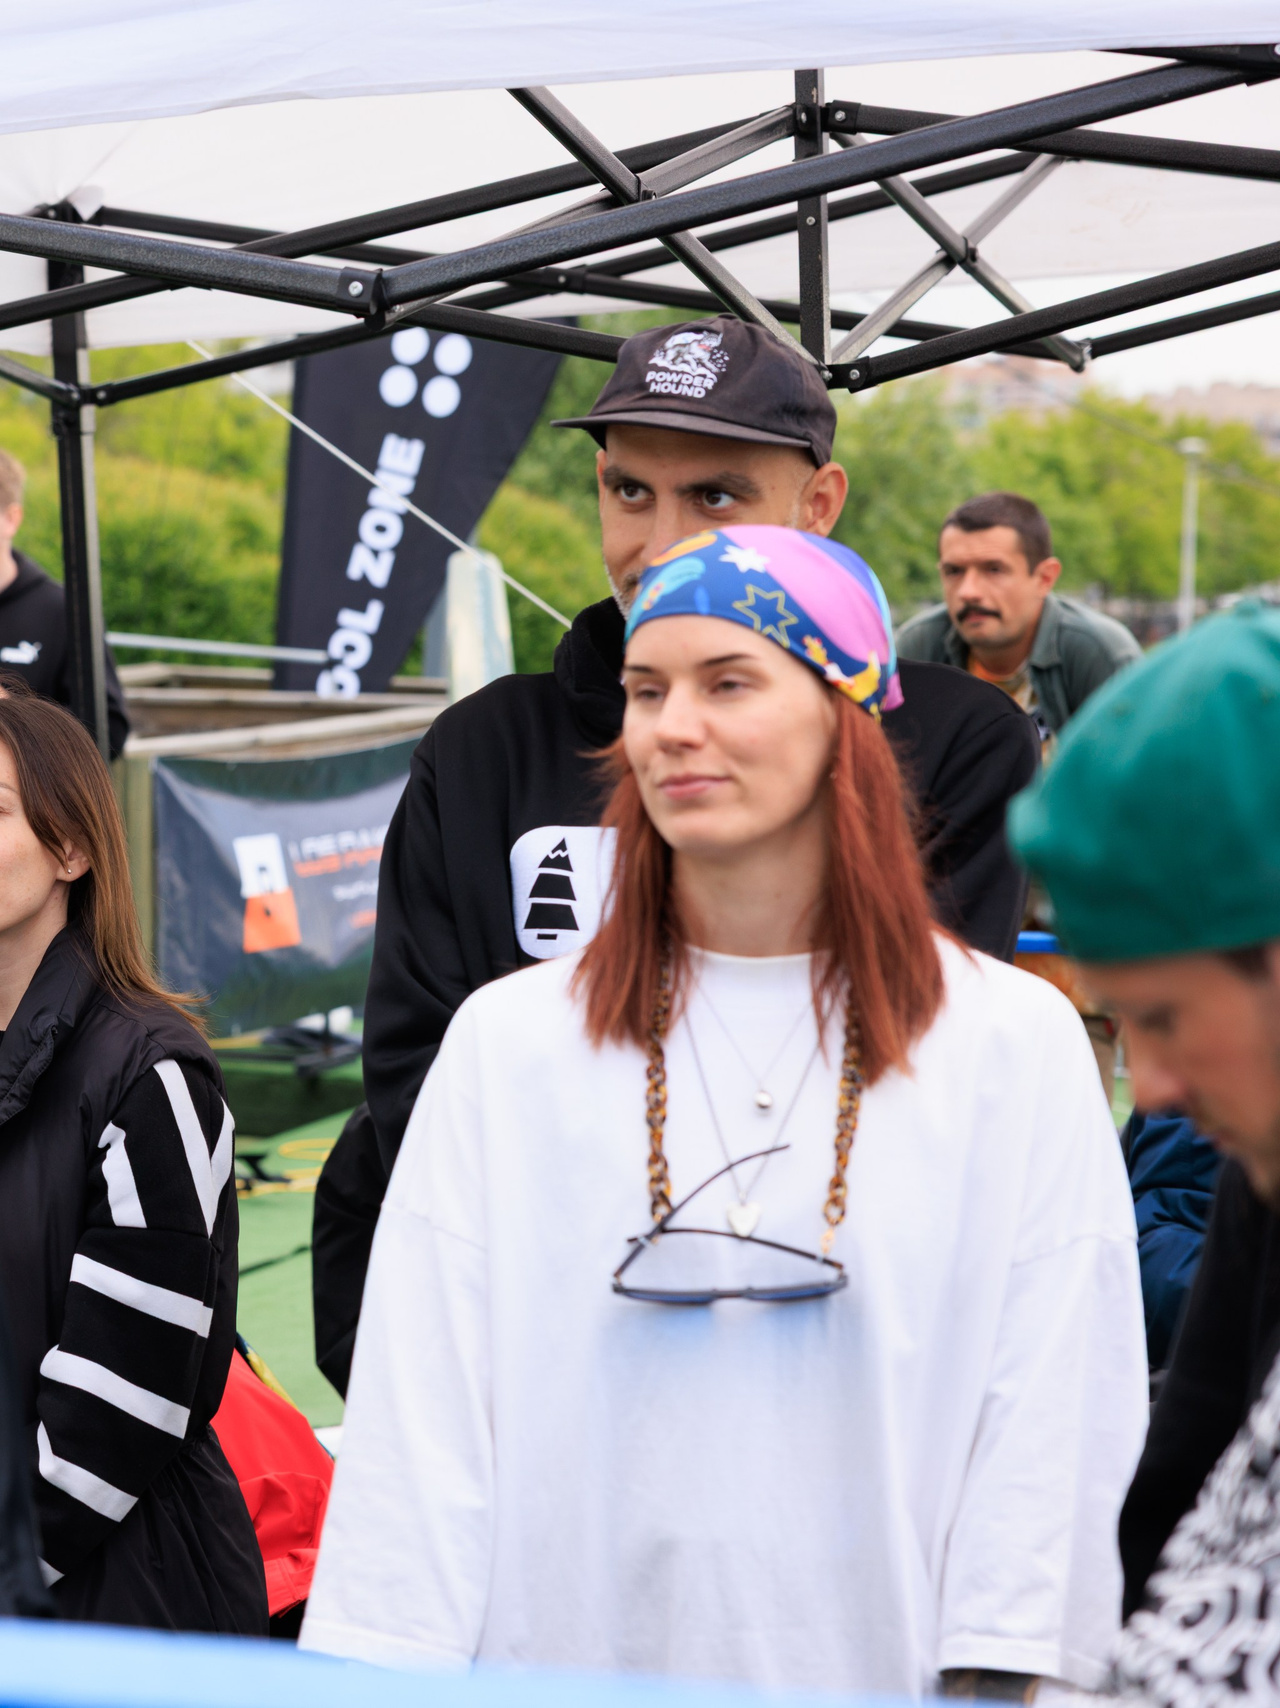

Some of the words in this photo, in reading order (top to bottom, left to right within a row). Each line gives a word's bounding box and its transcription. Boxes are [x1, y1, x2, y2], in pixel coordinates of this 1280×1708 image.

[645, 371, 715, 390] POWDER
[649, 382, 706, 398] HOUND
[346, 432, 425, 588] ZONE
